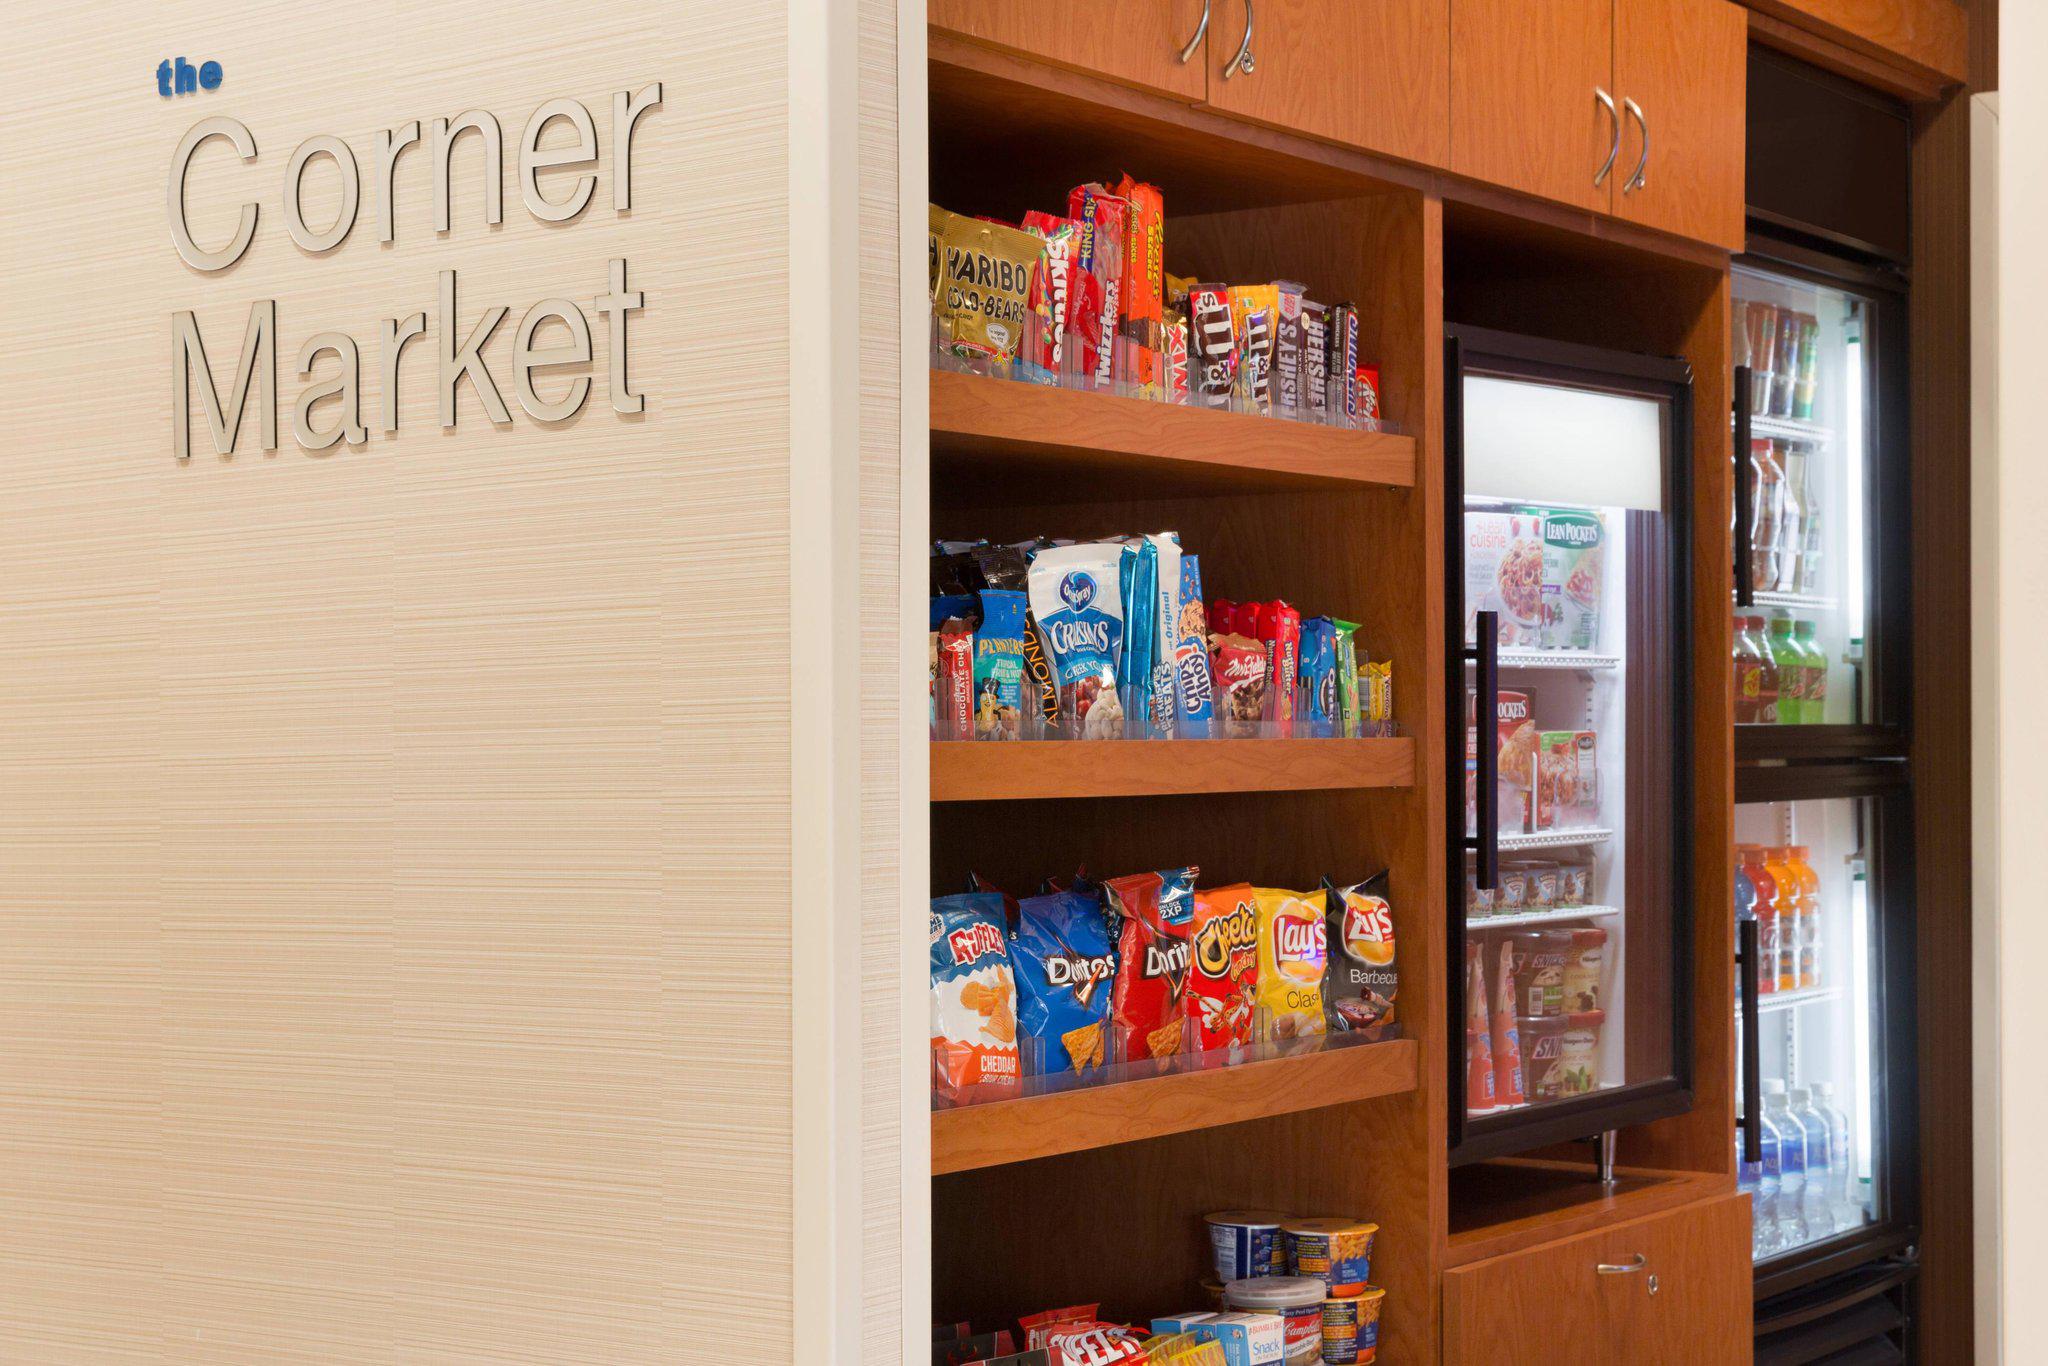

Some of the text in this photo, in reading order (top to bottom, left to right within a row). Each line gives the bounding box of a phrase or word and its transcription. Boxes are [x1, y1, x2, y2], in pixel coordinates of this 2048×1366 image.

[157, 57, 223, 96] the
[168, 82, 663, 272] Corner
[1081, 223, 1094, 258] KING
[947, 246, 1026, 296] HARIBO
[1095, 279, 1115, 388] Twizzlers
[172, 258, 645, 459] Market
[1167, 325, 1188, 404] WIX
[1278, 321, 1297, 418] ERSHEY'S
[1566, 522, 1598, 542] POCKETS
[1162, 592, 1173, 638] Original
[979, 638, 1025, 656] PLANTERS
[1051, 621, 1109, 655] CRAISINS
[959, 668, 967, 732] CHOCOLATE
[1498, 700, 1526, 719] OCKETS
[1160, 905, 1182, 920] 2XP
[1200, 905, 1257, 973] Cheeto
[1278, 917, 1327, 961] Lay's
[1146, 942, 1189, 976] Dorit
[1286, 990, 1320, 1009] Clas
[981, 1055, 1016, 1074] CHEDDAR
[1253, 1339, 1280, 1356] Snack
